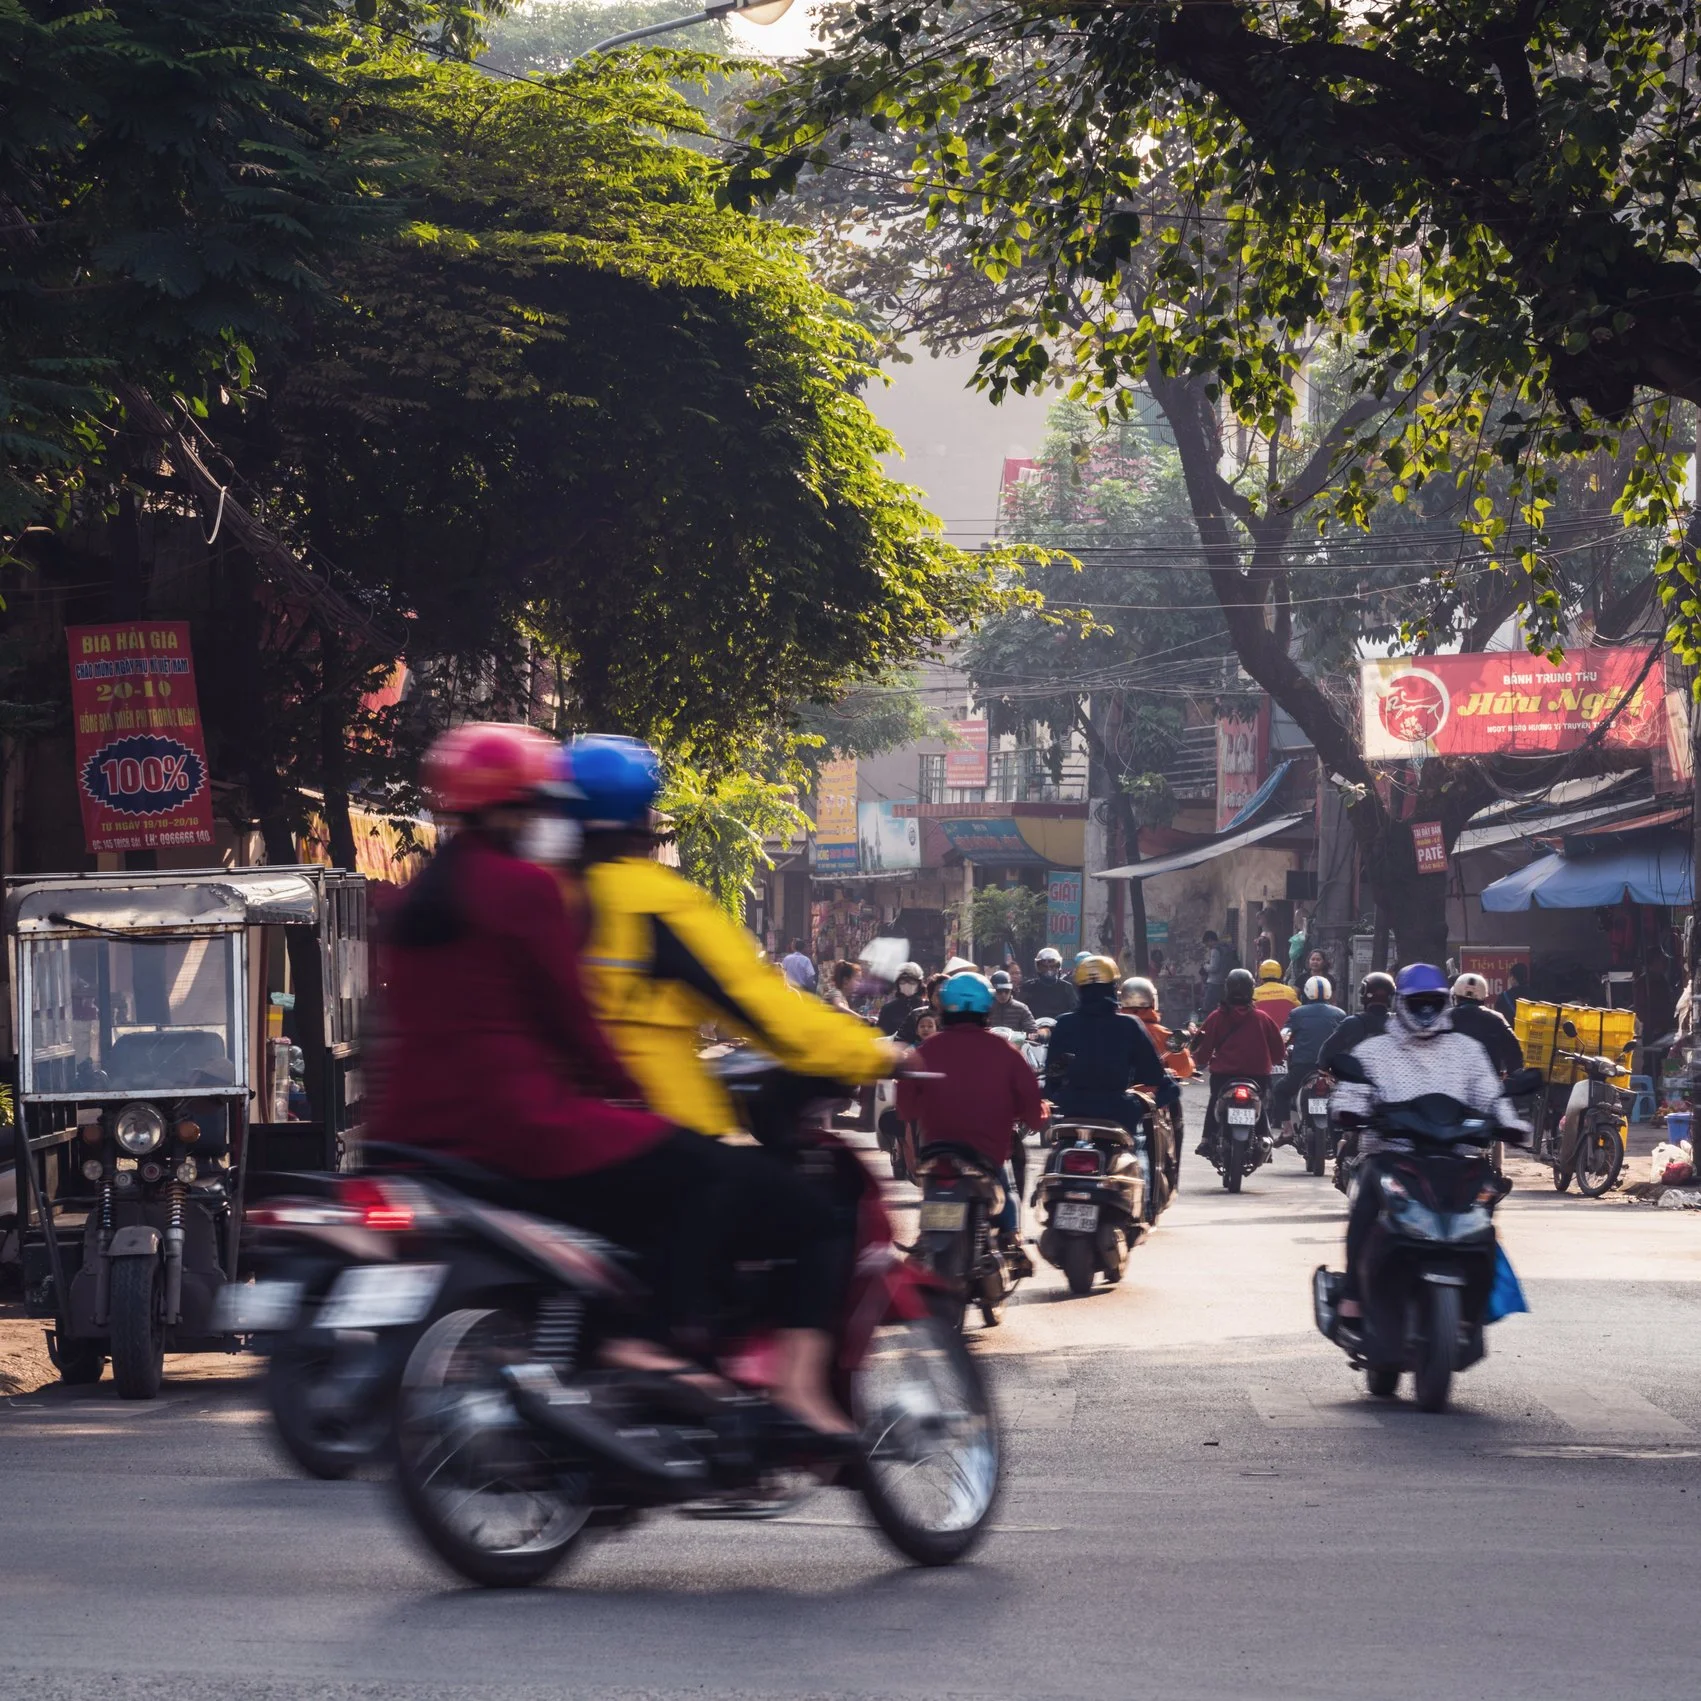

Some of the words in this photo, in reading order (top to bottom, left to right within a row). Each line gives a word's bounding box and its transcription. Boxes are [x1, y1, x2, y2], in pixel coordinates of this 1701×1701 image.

[82, 634, 111, 654] BIA
[116, 627, 146, 651] HẢI
[150, 631, 178, 649] GIA
[1503, 670, 1532, 685] BÁNH
[1536, 671, 1573, 684] TRUNG
[1575, 671, 1597, 682] THU
[96, 680, 172, 702] 20-10
[1457, 691, 1542, 716] Hữu
[100, 755, 189, 795] 100%
[1418, 843, 1444, 862] PATÊ
